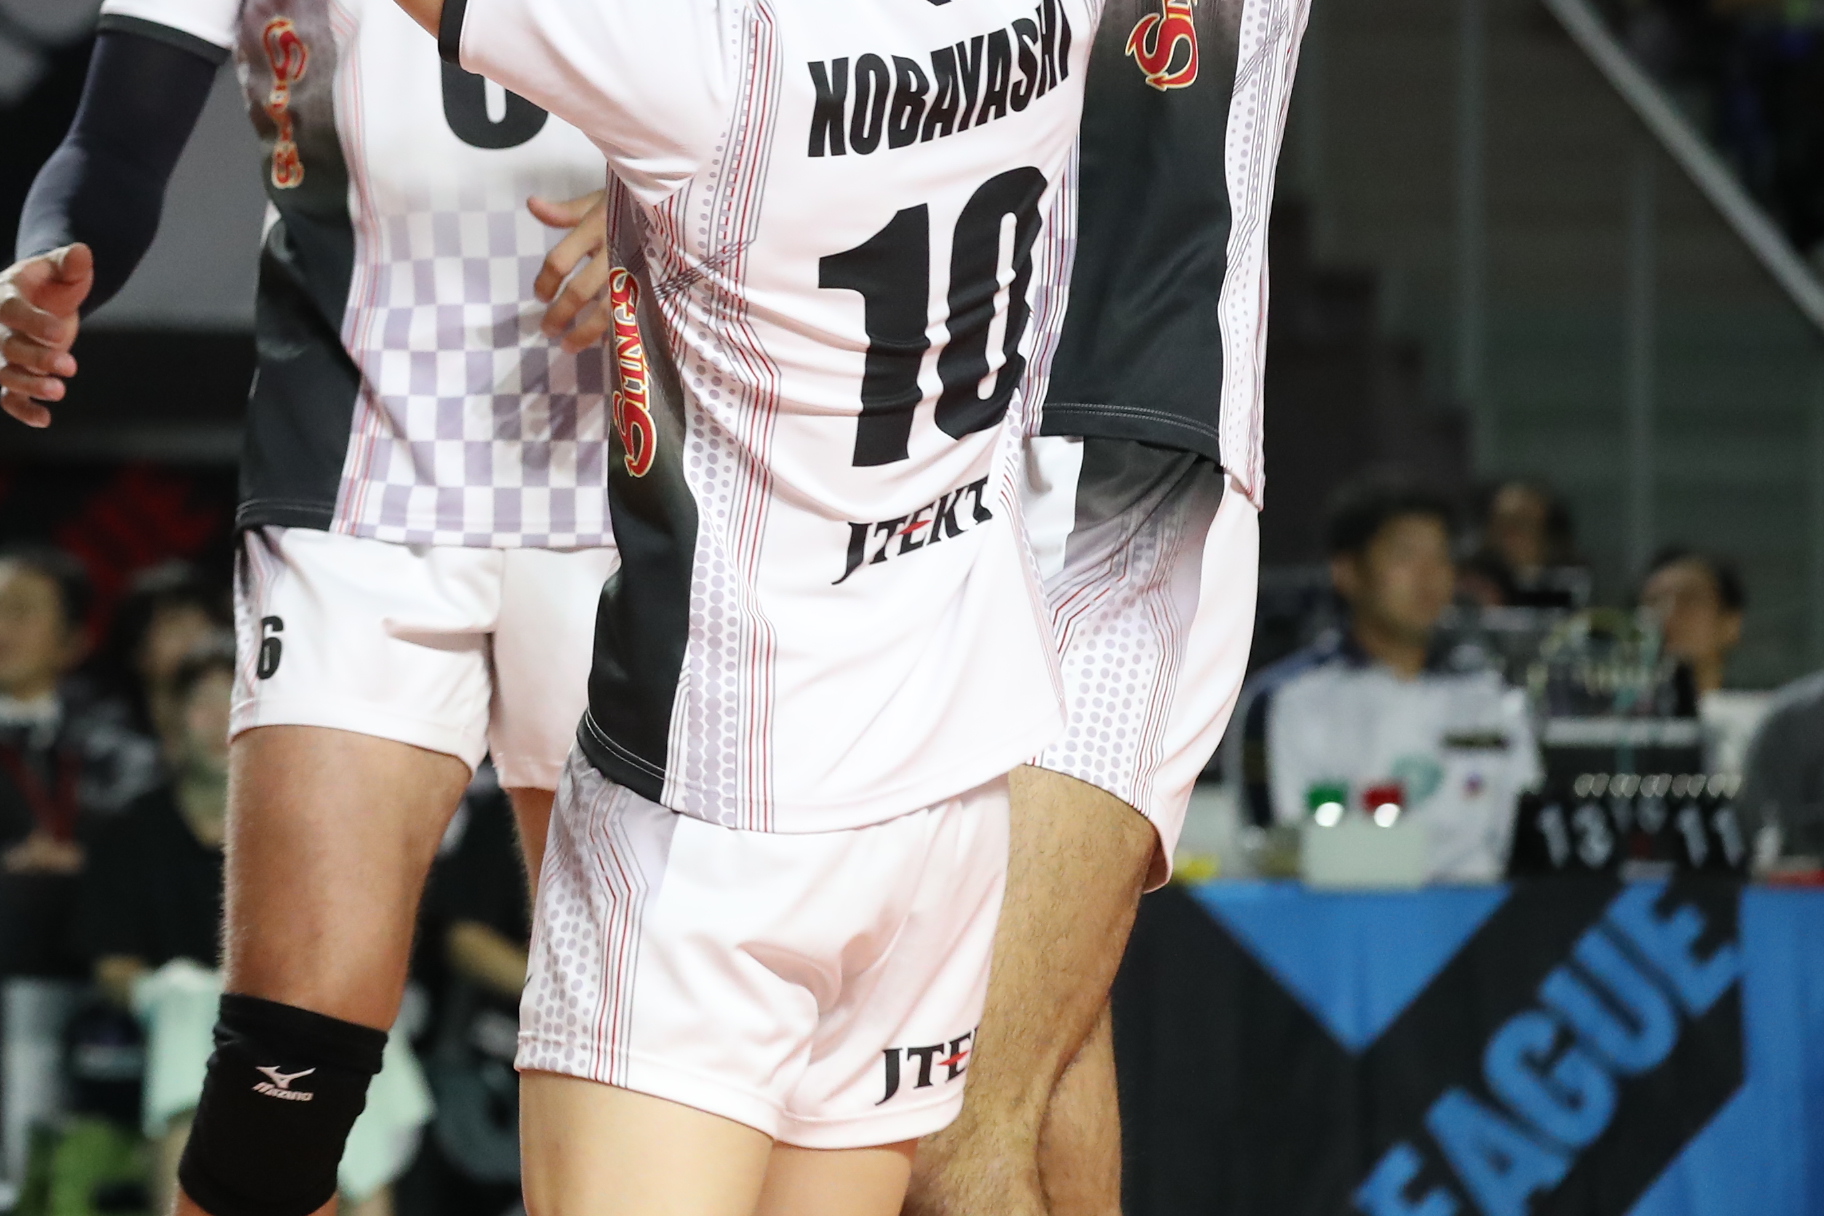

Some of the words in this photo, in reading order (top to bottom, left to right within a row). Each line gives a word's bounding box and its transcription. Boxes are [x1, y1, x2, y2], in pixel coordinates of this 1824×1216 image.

[817, 165, 1049, 468] 10
[607, 266, 659, 479] STINGS
[831, 476, 994, 586] JTEKT
[256, 615, 285, 681] 6
[874, 1024, 980, 1106] JTE
